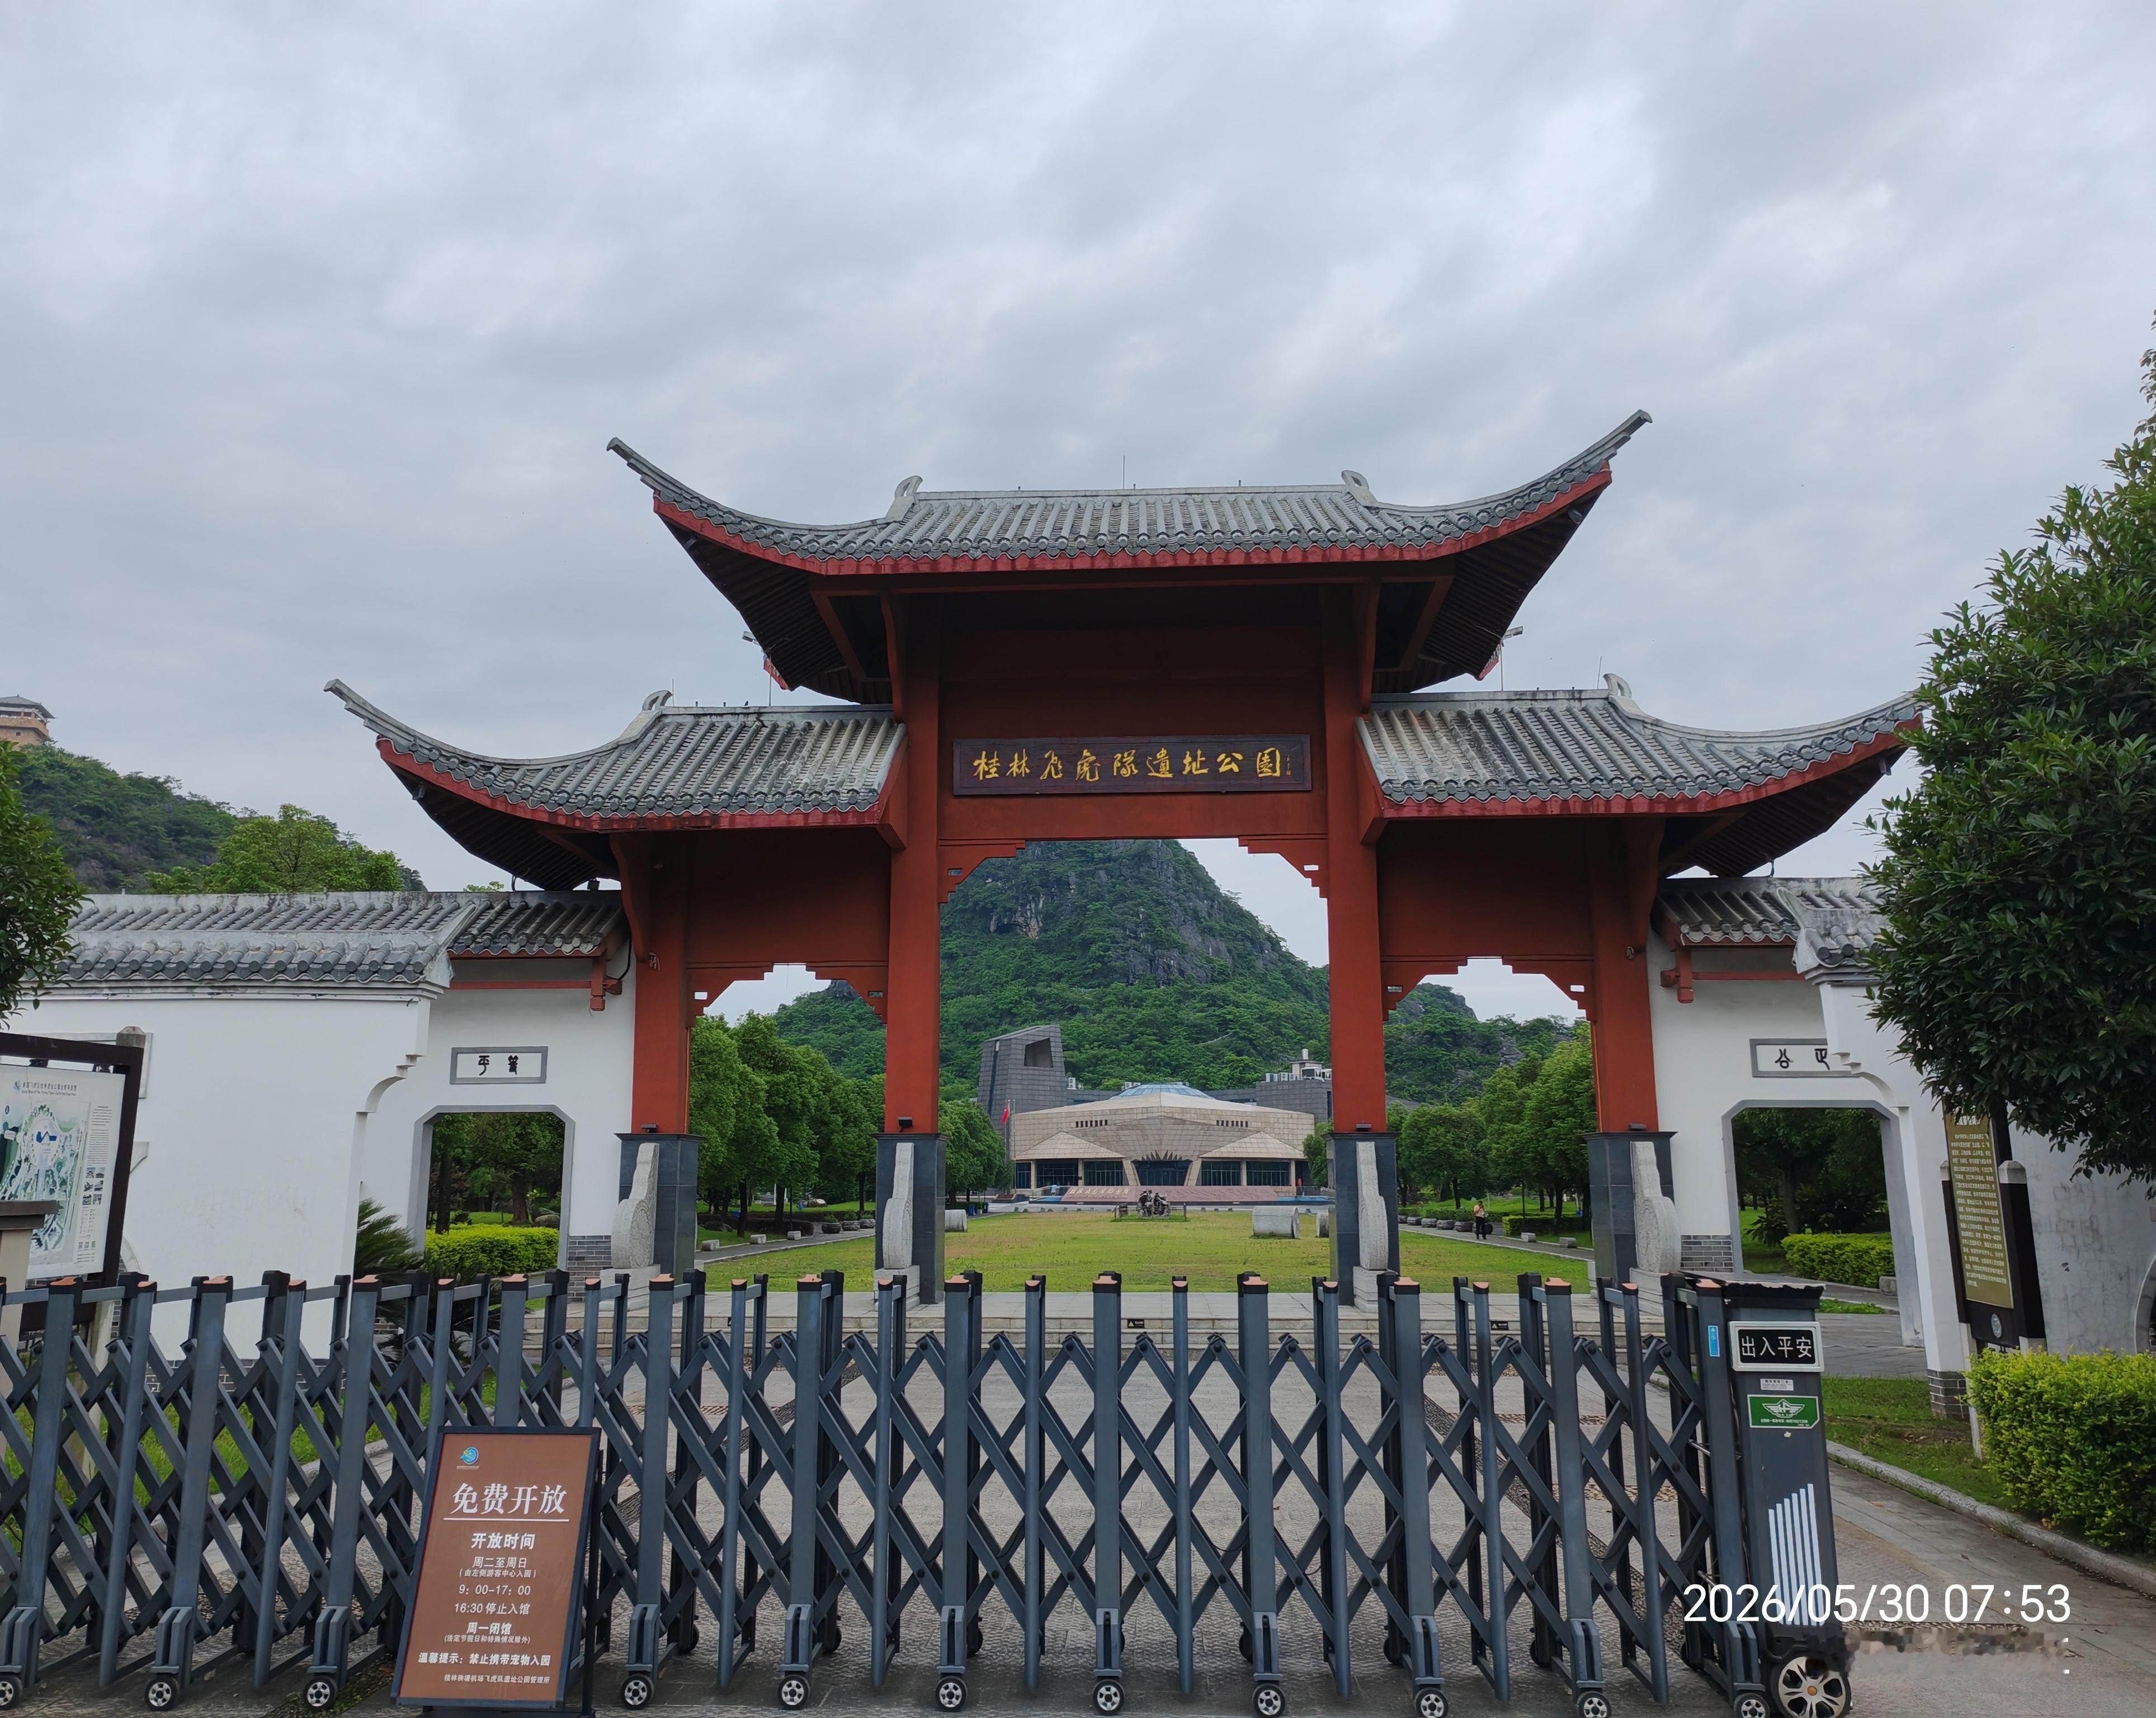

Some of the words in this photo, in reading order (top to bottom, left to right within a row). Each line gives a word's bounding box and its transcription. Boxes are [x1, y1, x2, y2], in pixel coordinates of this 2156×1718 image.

[1742, 1336, 1811, 1358] 出入平安
[450, 1483, 567, 1514] 免费开放
[471, 1532, 535, 1550] 开放时间
[472, 1557, 527, 1568] 周二至周日
[455, 1603, 483, 1613] 16:30
[485, 1602, 530, 1615] 停止入馆
[466, 1622, 512, 1635] 周一闭馆
